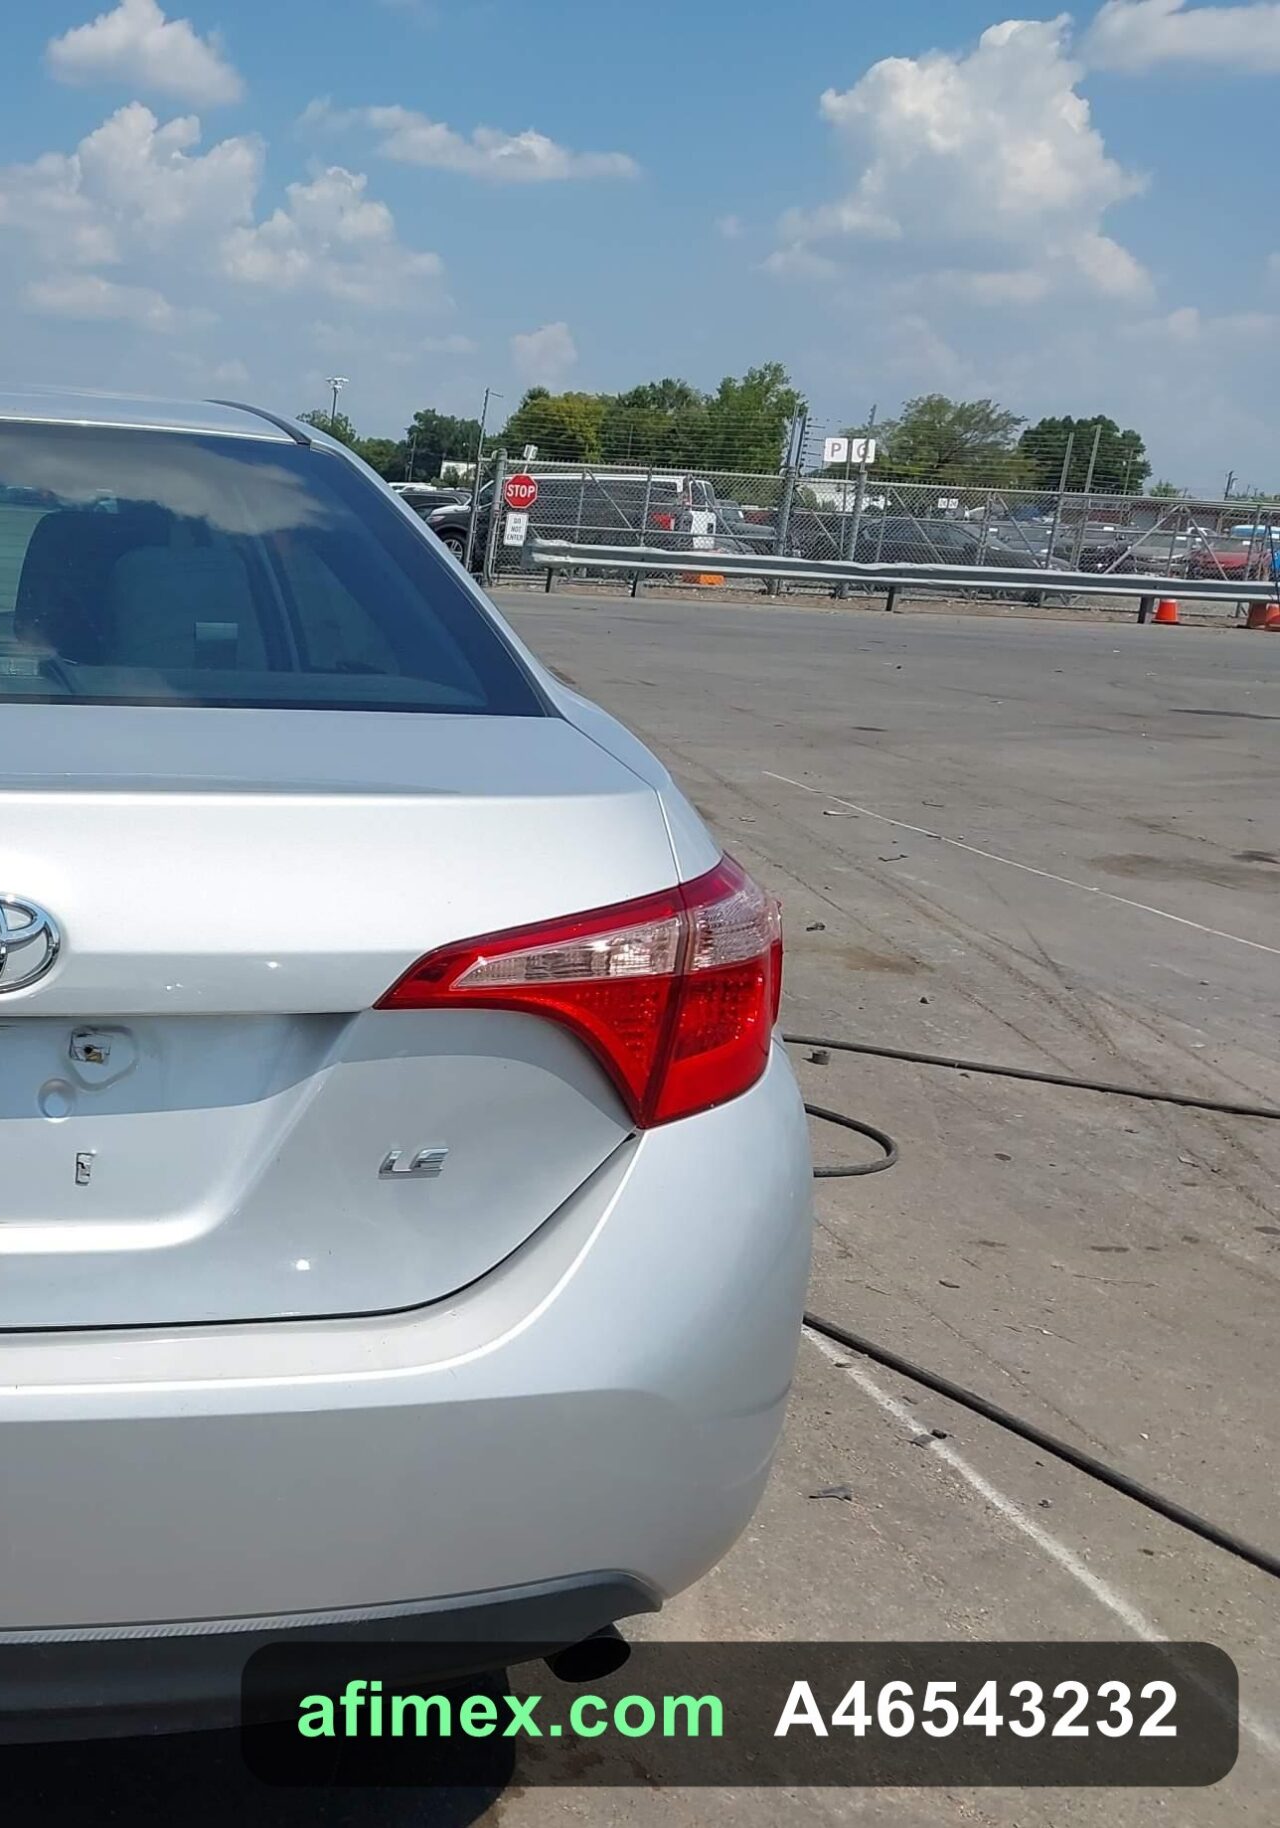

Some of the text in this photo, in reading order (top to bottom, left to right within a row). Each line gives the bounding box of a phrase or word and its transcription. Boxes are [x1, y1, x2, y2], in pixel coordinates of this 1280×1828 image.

[831, 442, 842, 457] P
[506, 484, 536, 498] STOP
[511, 525, 522, 533] NOT
[379, 1148, 449, 1179] LE
